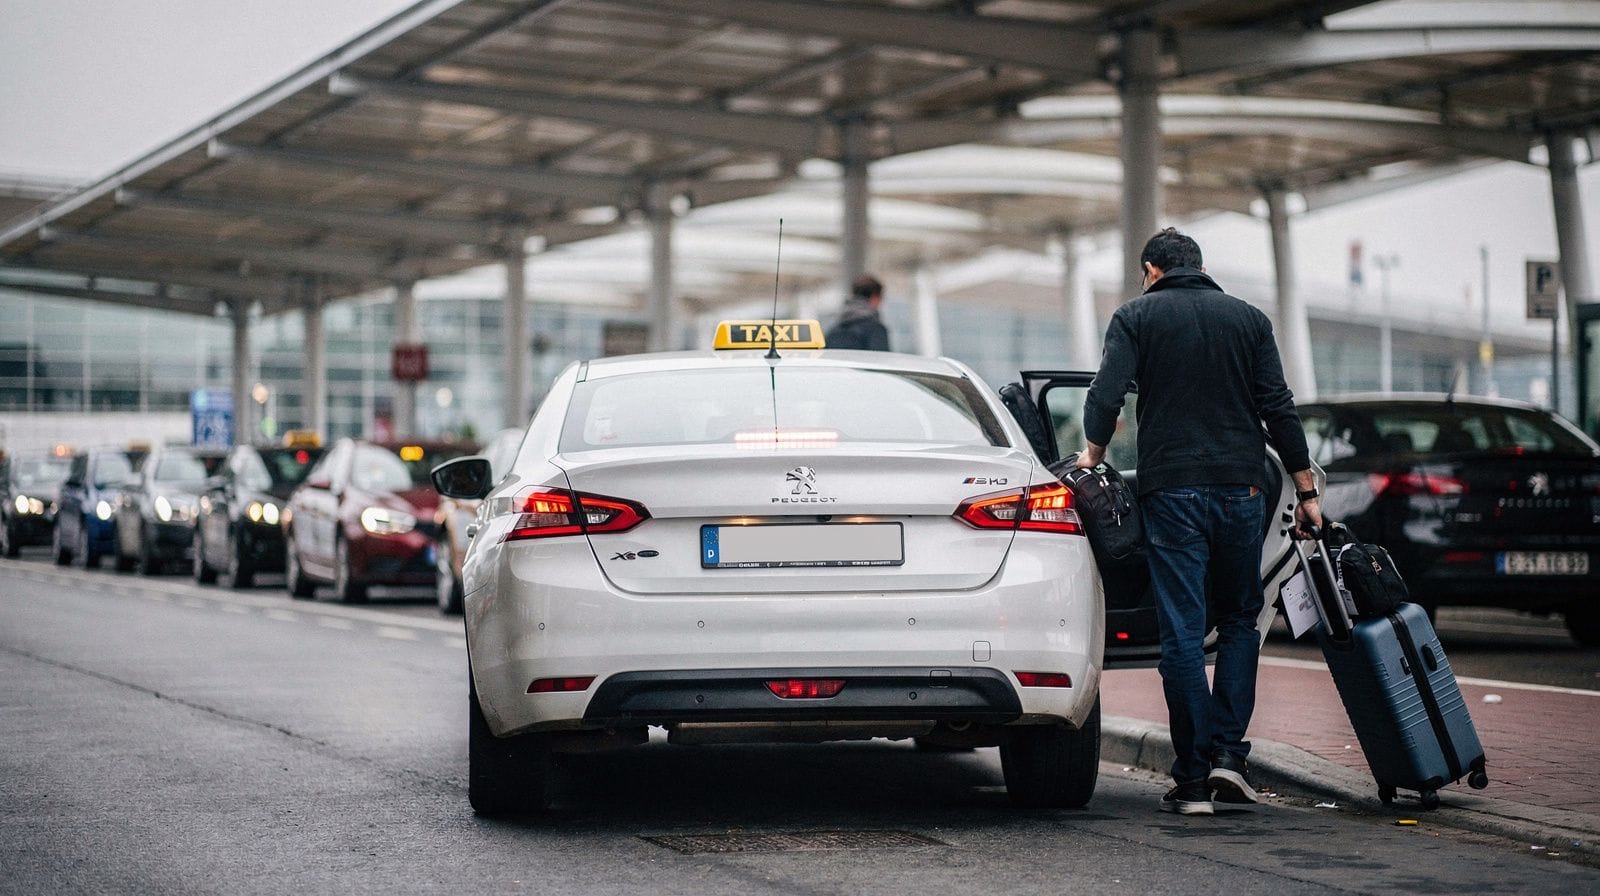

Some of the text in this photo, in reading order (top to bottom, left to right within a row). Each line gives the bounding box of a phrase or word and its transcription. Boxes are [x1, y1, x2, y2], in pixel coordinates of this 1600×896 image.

[1537, 266, 1552, 293] P
[740, 325, 799, 342] TAXI
[707, 550, 715, 559] D
